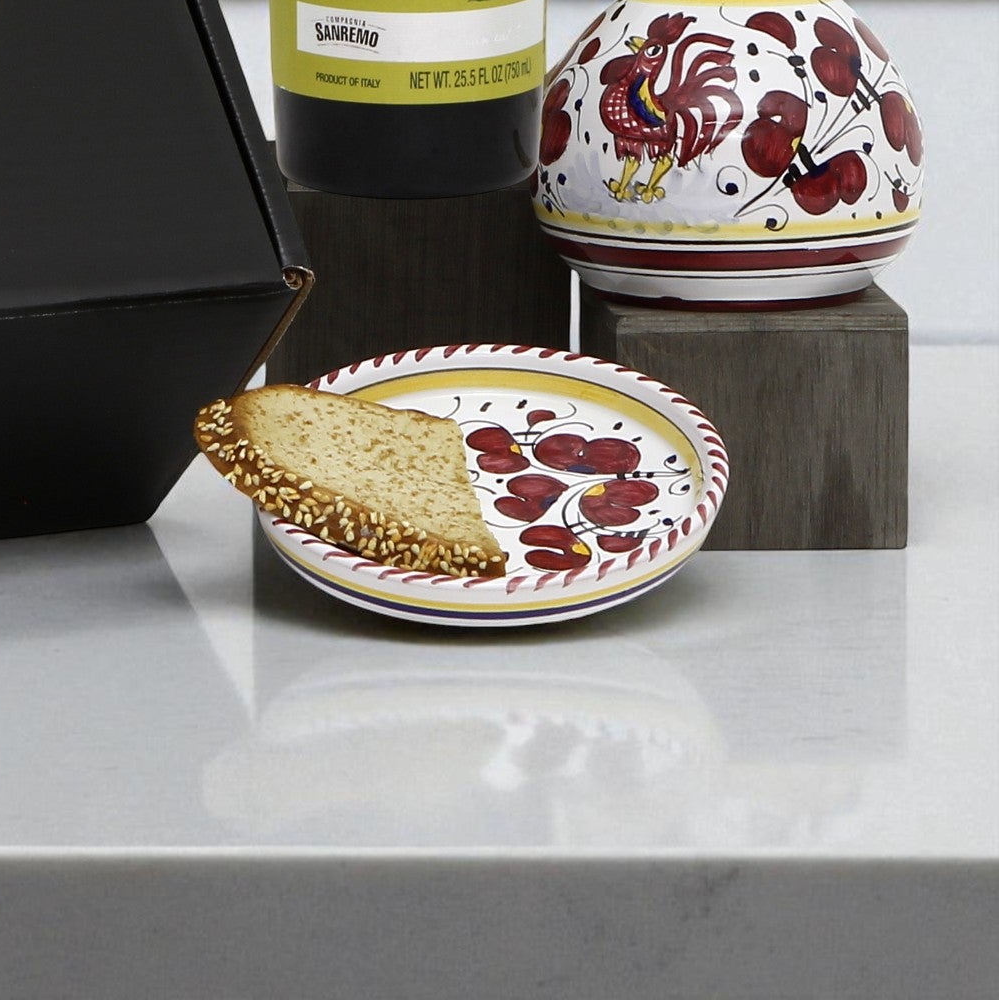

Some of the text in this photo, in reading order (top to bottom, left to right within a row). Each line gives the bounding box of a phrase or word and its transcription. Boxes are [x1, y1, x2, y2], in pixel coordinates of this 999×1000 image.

[326, 15, 367, 27] COMPAGNIA
[315, 22, 380, 48] SANREMO
[315, 71, 382, 89] PRODUCT OF ITALY
[409, 71, 431, 90] NET
[433, 70, 452, 89] WT.
[454, 69, 476, 88] 25.5
[478, 66, 490, 85] FL
[491, 64, 503, 84] OZ
[504, 60, 521, 84] (750
